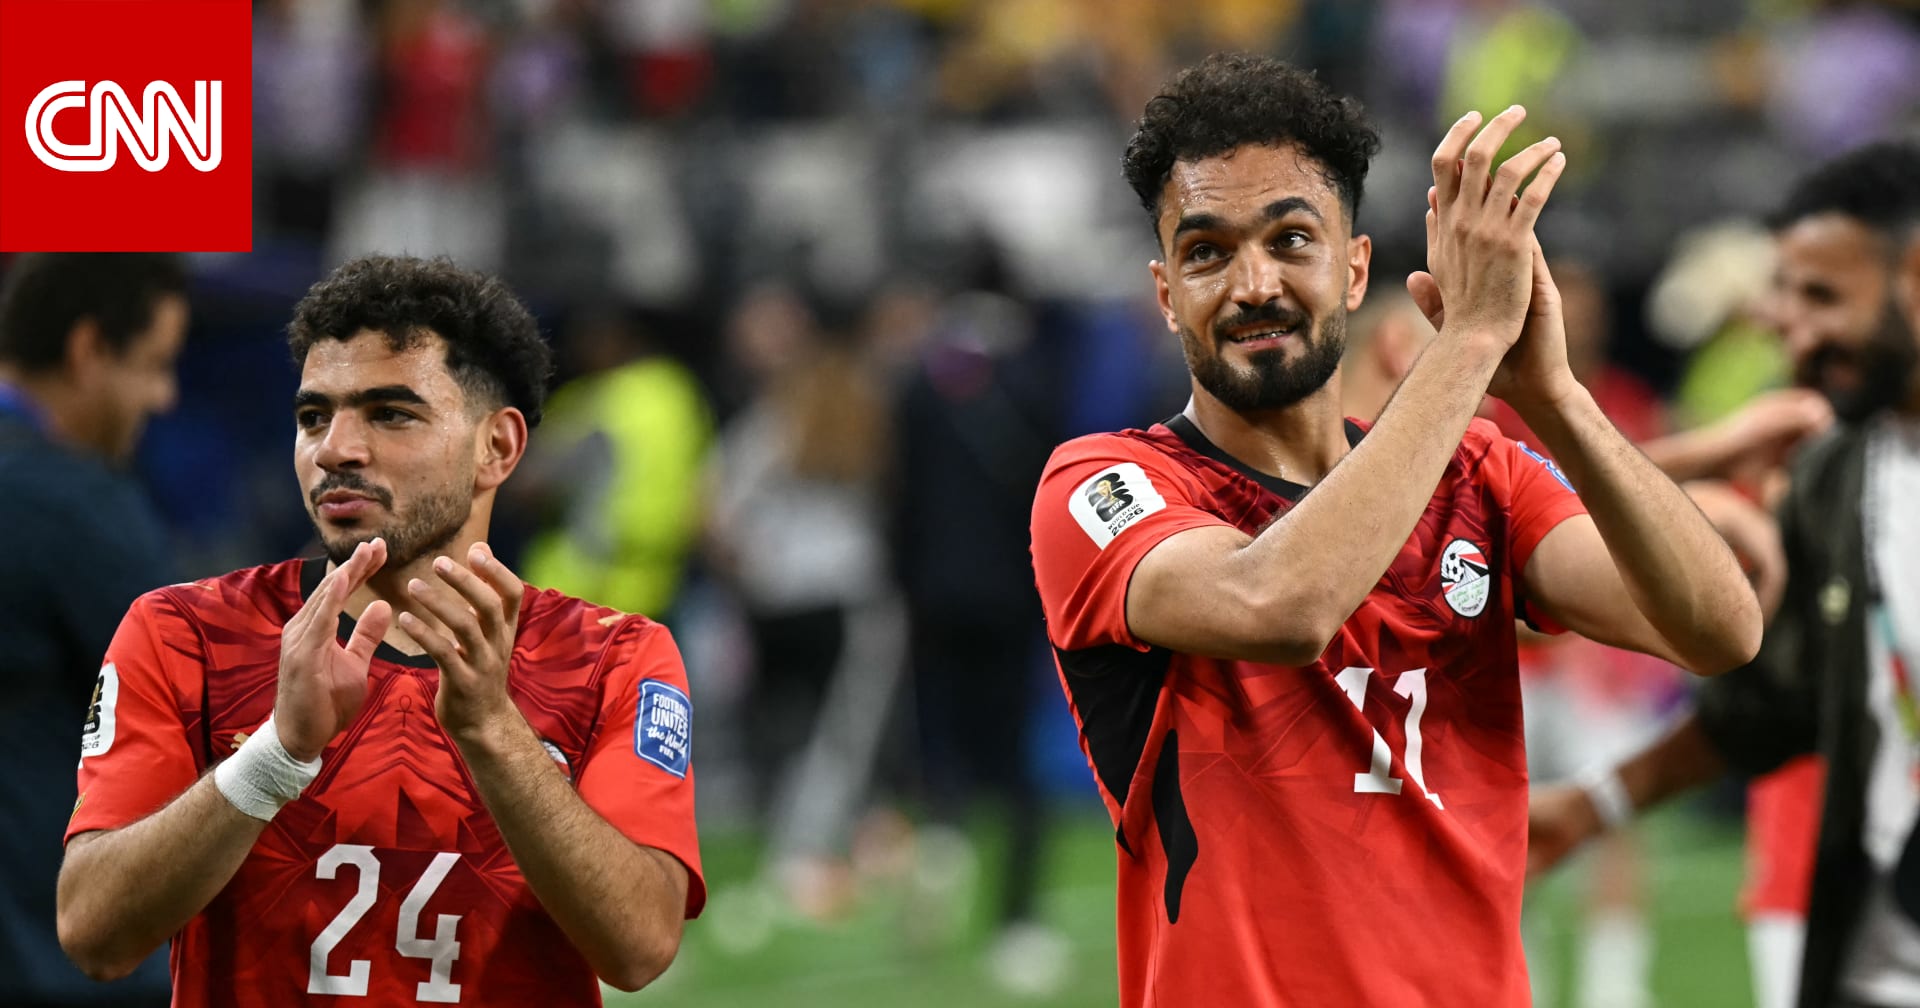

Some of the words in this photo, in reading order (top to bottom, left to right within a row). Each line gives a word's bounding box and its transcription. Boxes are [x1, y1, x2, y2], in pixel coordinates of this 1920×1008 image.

[1108, 500, 1126, 515] FIFA
[1111, 507, 1144, 536] 2026
[653, 693, 688, 722] FOOTBALL
[646, 726, 665, 741] the
[651, 706, 688, 739] UNITES
[659, 744, 674, 760] FIFA
[1334, 666, 1444, 810] 11
[307, 843, 463, 1003] 24
